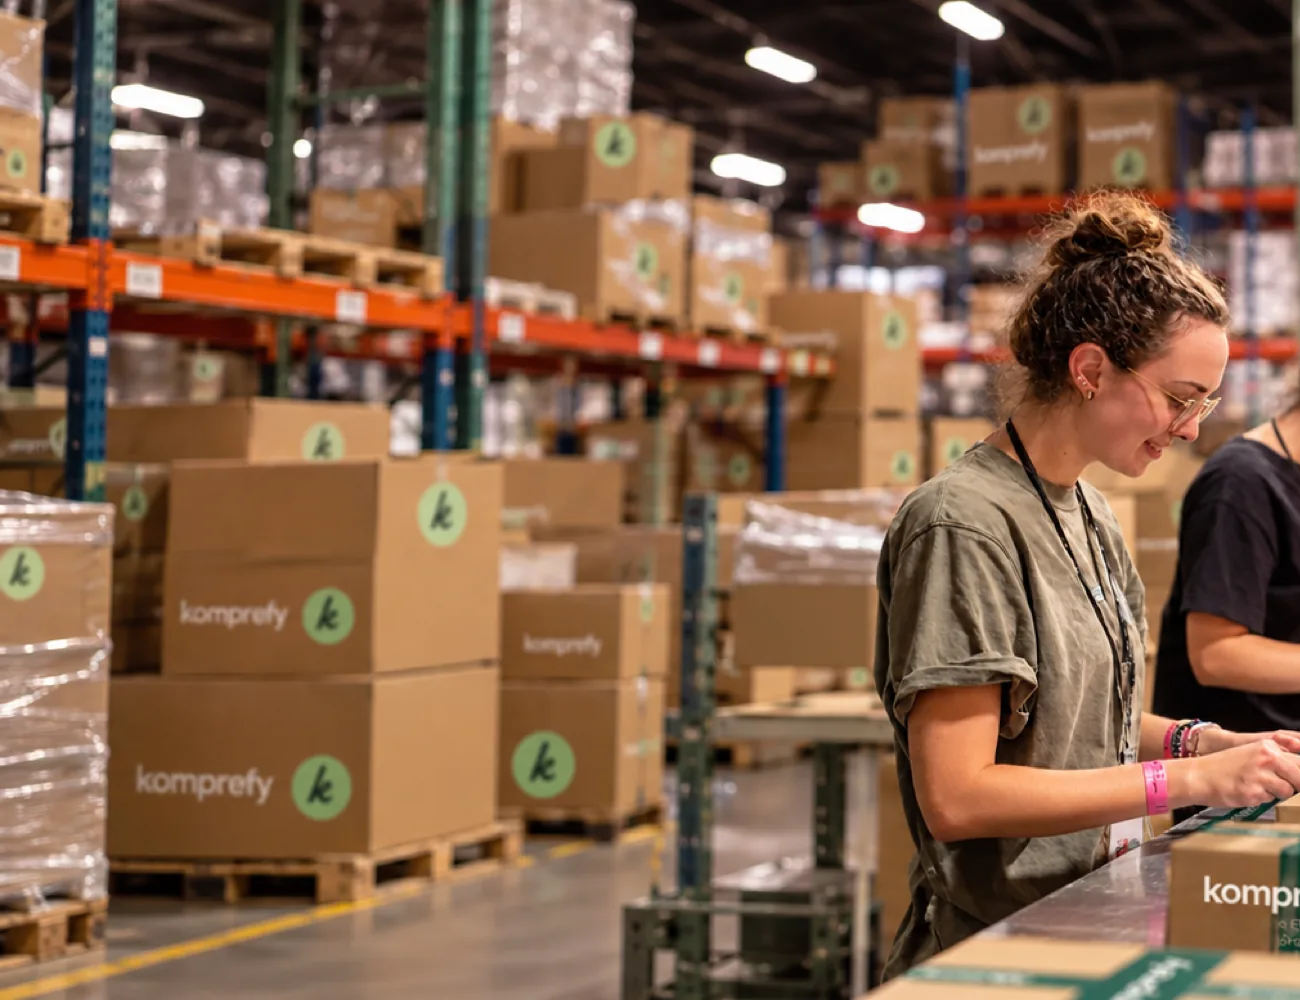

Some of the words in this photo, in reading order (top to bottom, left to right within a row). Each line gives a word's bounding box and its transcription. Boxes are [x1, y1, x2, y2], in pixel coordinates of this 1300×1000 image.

[180, 597, 289, 632] komprefy
[315, 595, 340, 631] k
[529, 741, 556, 783] k
[136, 763, 274, 806] komprefy
[306, 764, 334, 806] k
